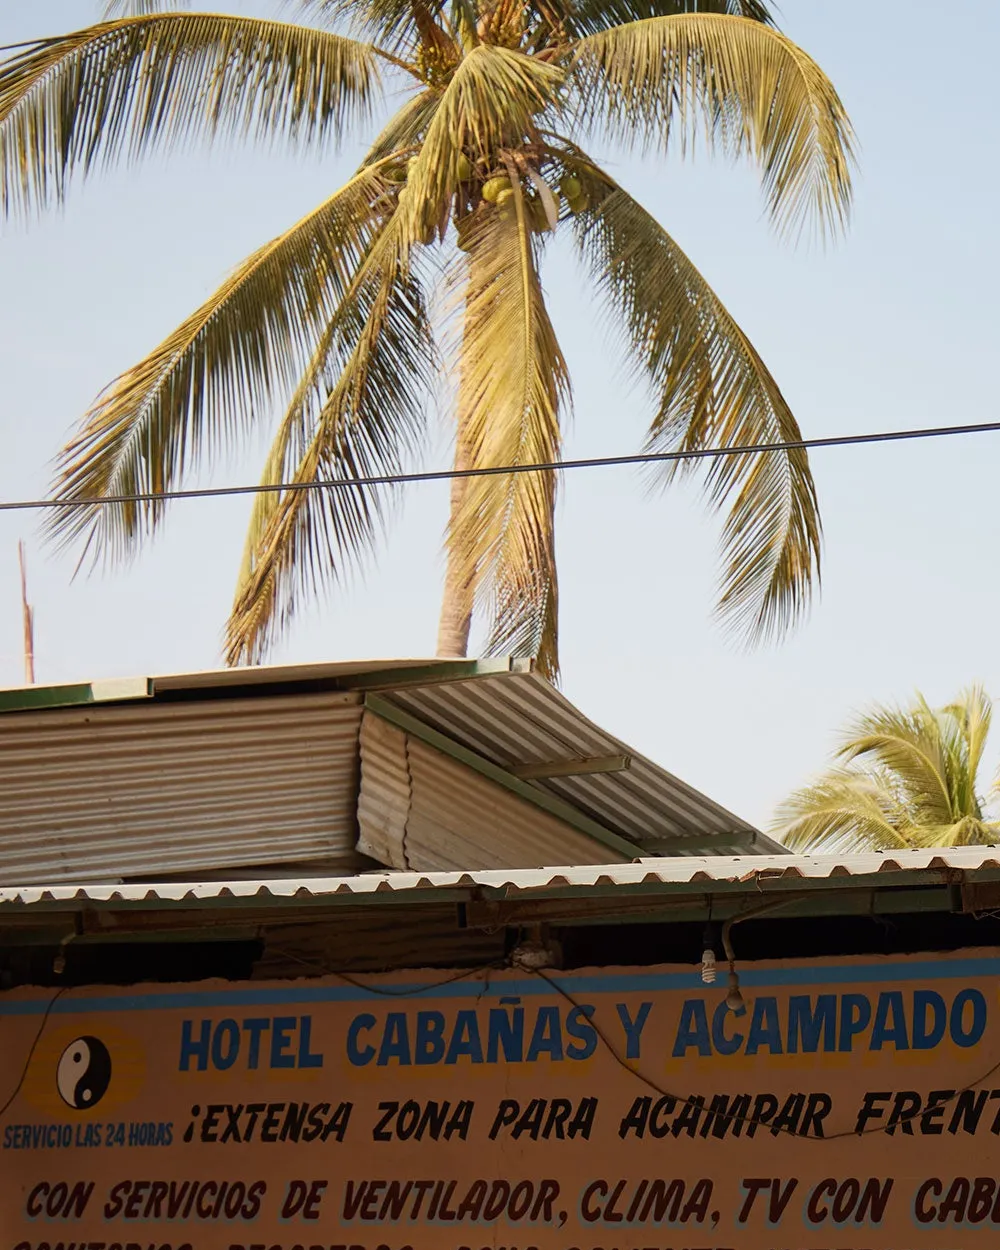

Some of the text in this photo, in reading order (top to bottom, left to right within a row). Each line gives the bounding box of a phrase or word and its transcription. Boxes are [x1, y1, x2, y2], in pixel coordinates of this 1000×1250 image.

[179, 1015, 324, 1071] HOTEL
[346, 997, 599, 1066] CABAÑAS
[616, 1002, 653, 1060] Y
[672, 988, 988, 1058] ACAMPADO
[3, 1122, 173, 1149] SERVICIO LAS 24 HORAS
[183, 1101, 354, 1143] ¡EXTENSA
[373, 1099, 475, 1140] ZONA
[490, 1096, 599, 1142] PARA
[620, 1091, 832, 1139] ACAMPAR
[25, 1181, 96, 1218] CON
[104, 1181, 266, 1219] SERVICIOS
[281, 1180, 328, 1220] DE
[344, 1178, 569, 1228] VENTILADOR,
[580, 1179, 722, 1228] CLIMA,
[738, 1178, 800, 1223] TV
[807, 1178, 893, 1223] CON
